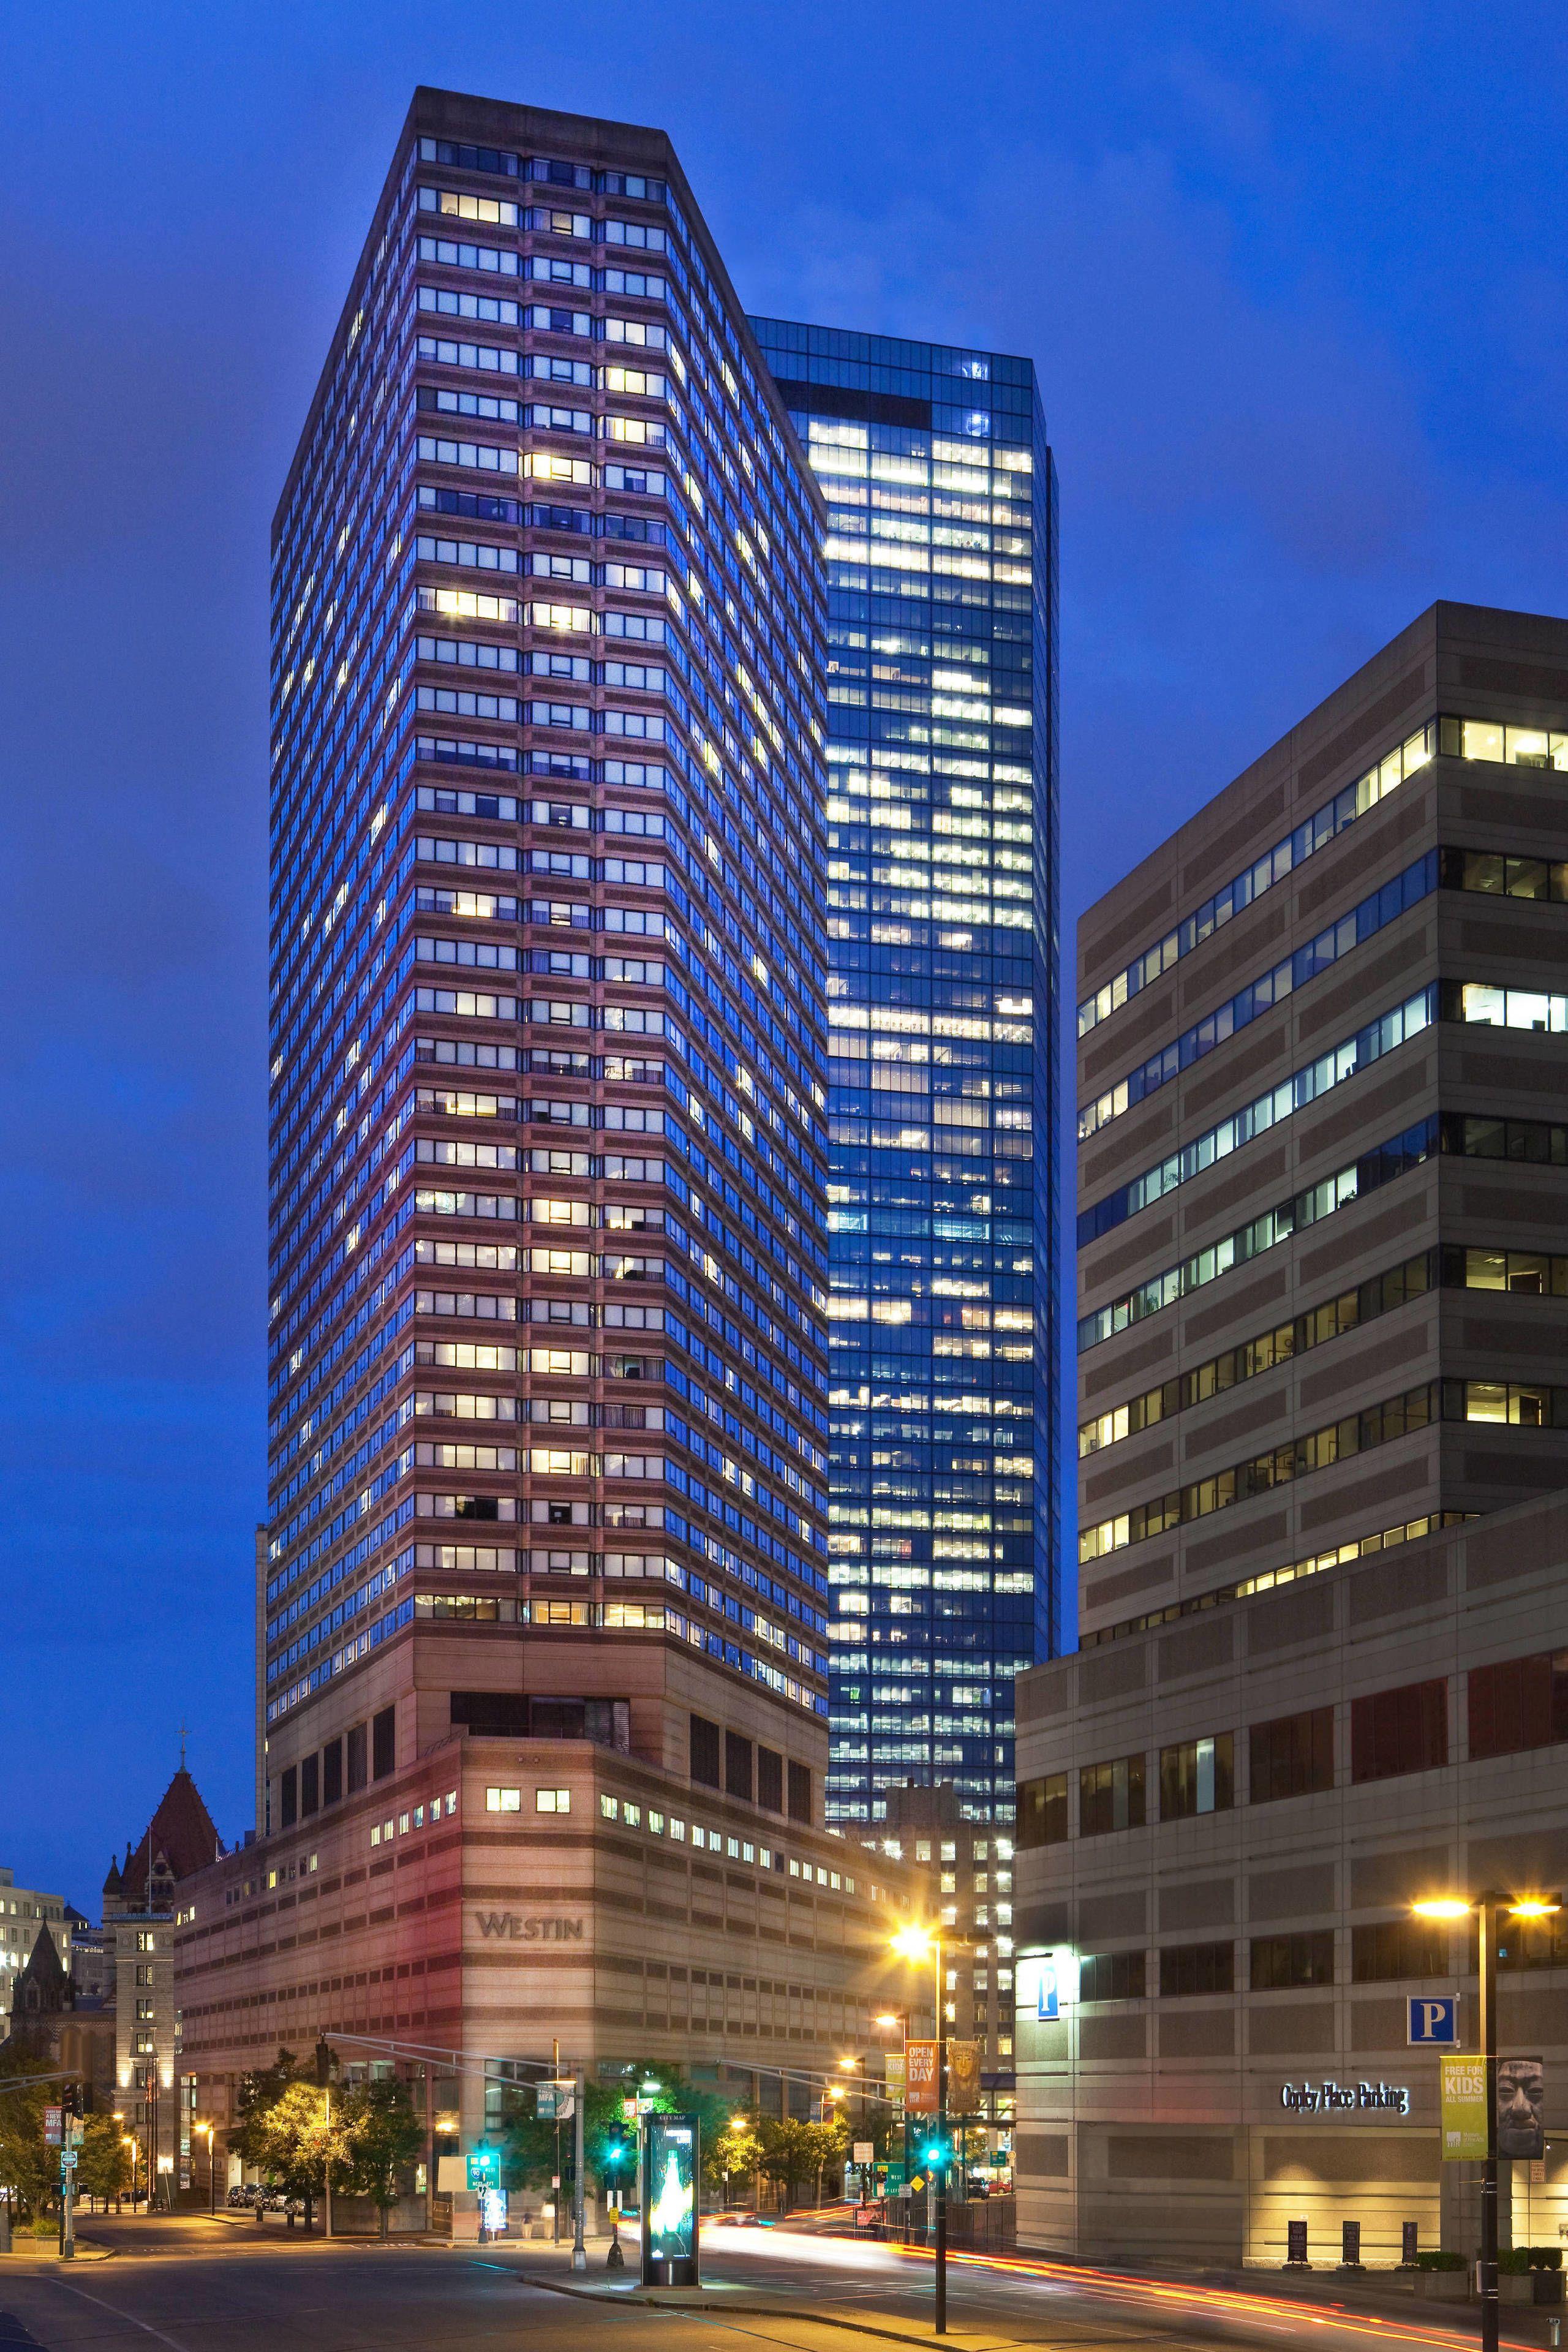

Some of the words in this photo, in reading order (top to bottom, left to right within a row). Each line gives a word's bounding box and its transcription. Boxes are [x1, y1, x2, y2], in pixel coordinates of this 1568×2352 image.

[475, 1912, 583, 1940] WESTIN
[1041, 1970, 1055, 2011] P
[1420, 2003, 1446, 2038] P
[909, 2047, 933, 2057] OPEN
[909, 2058, 933, 2067] EVERY
[1445, 2066, 1464, 2075] FREE
[1467, 2066, 1483, 2075] FOR
[909, 2067, 934, 2081] DAY
[1445, 2076, 1483, 2095] KIDS
[1280, 2082, 1321, 2113] Copley
[1321, 2082, 1355, 2108] Place
[1355, 2082, 1409, 2114] Parking
